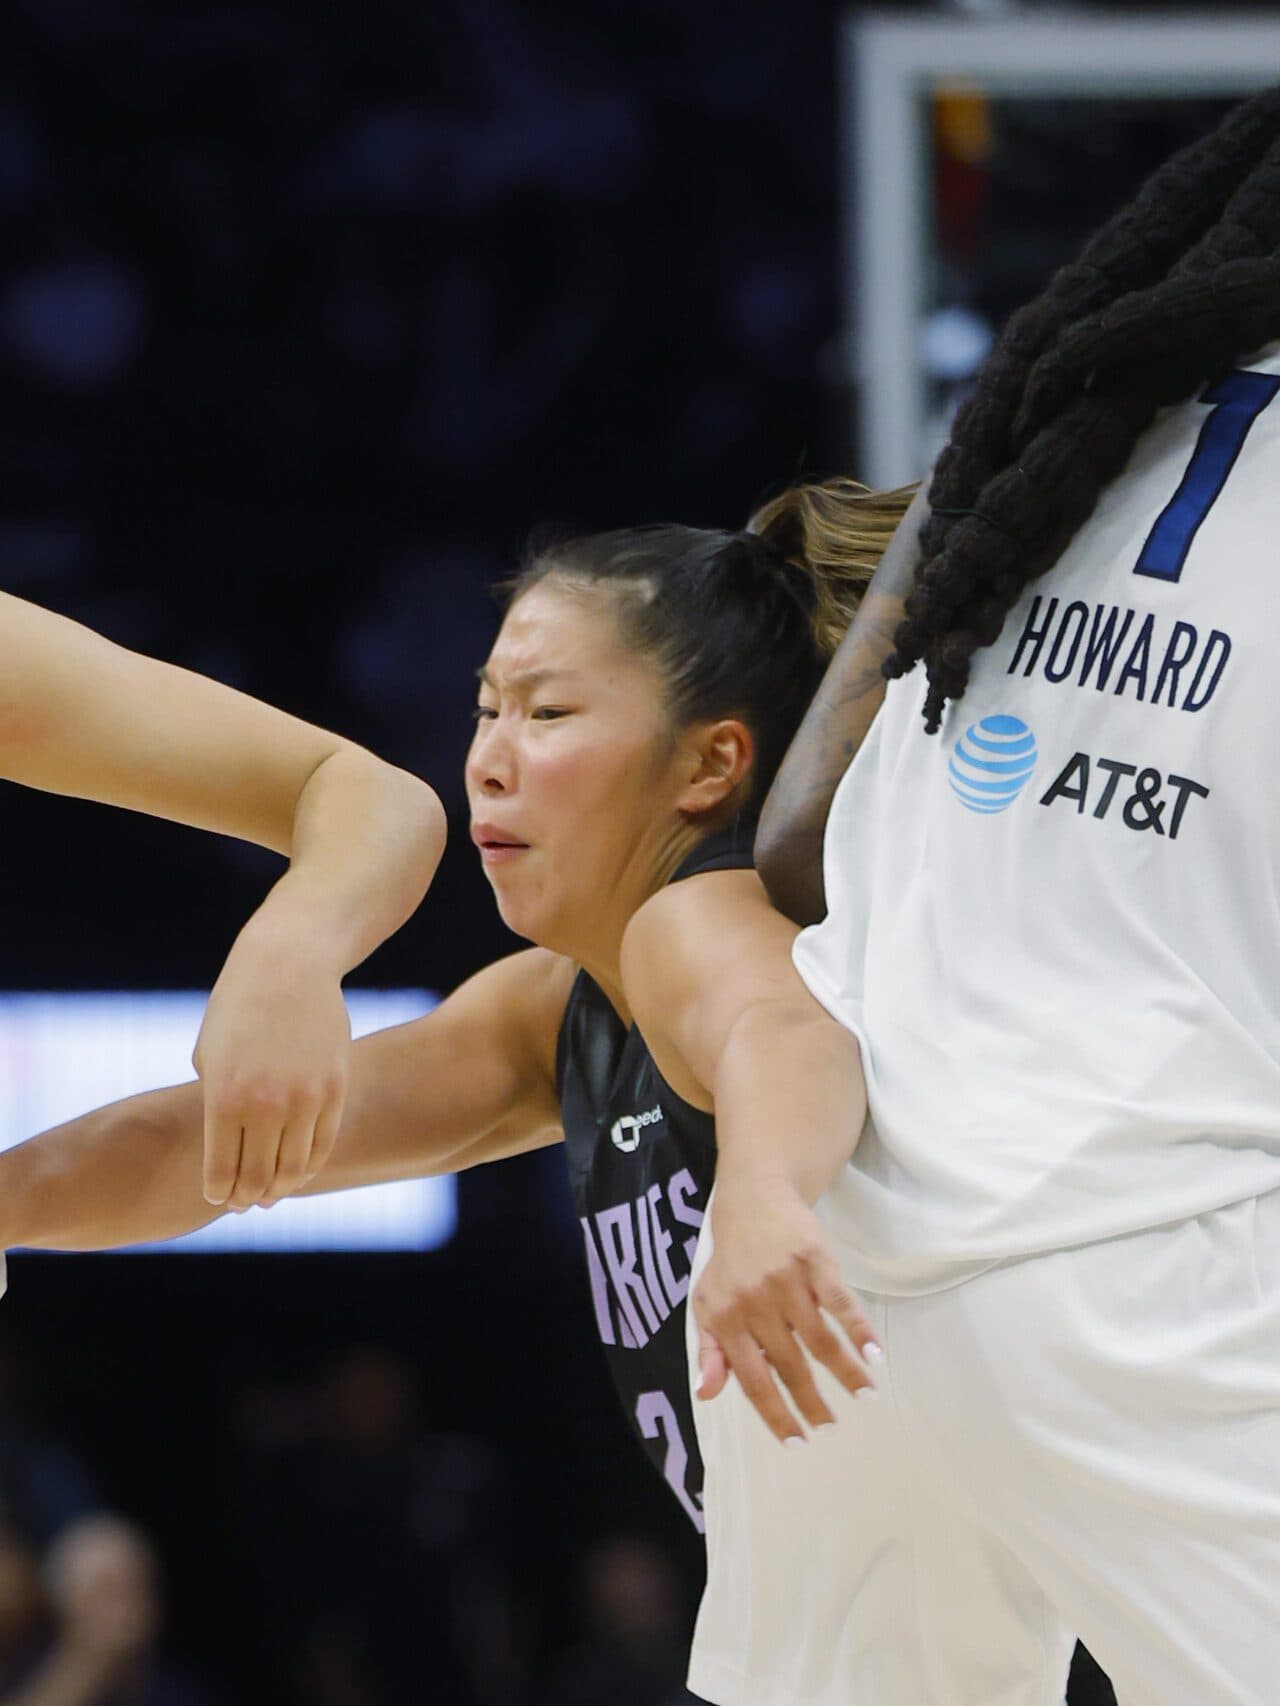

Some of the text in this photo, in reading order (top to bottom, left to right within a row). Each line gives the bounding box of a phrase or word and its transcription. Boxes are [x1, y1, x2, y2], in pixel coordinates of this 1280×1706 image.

[1132, 369, 1280, 584] 1
[1007, 595, 1232, 712] HOWARD
[1039, 752, 1210, 840] AT&T
